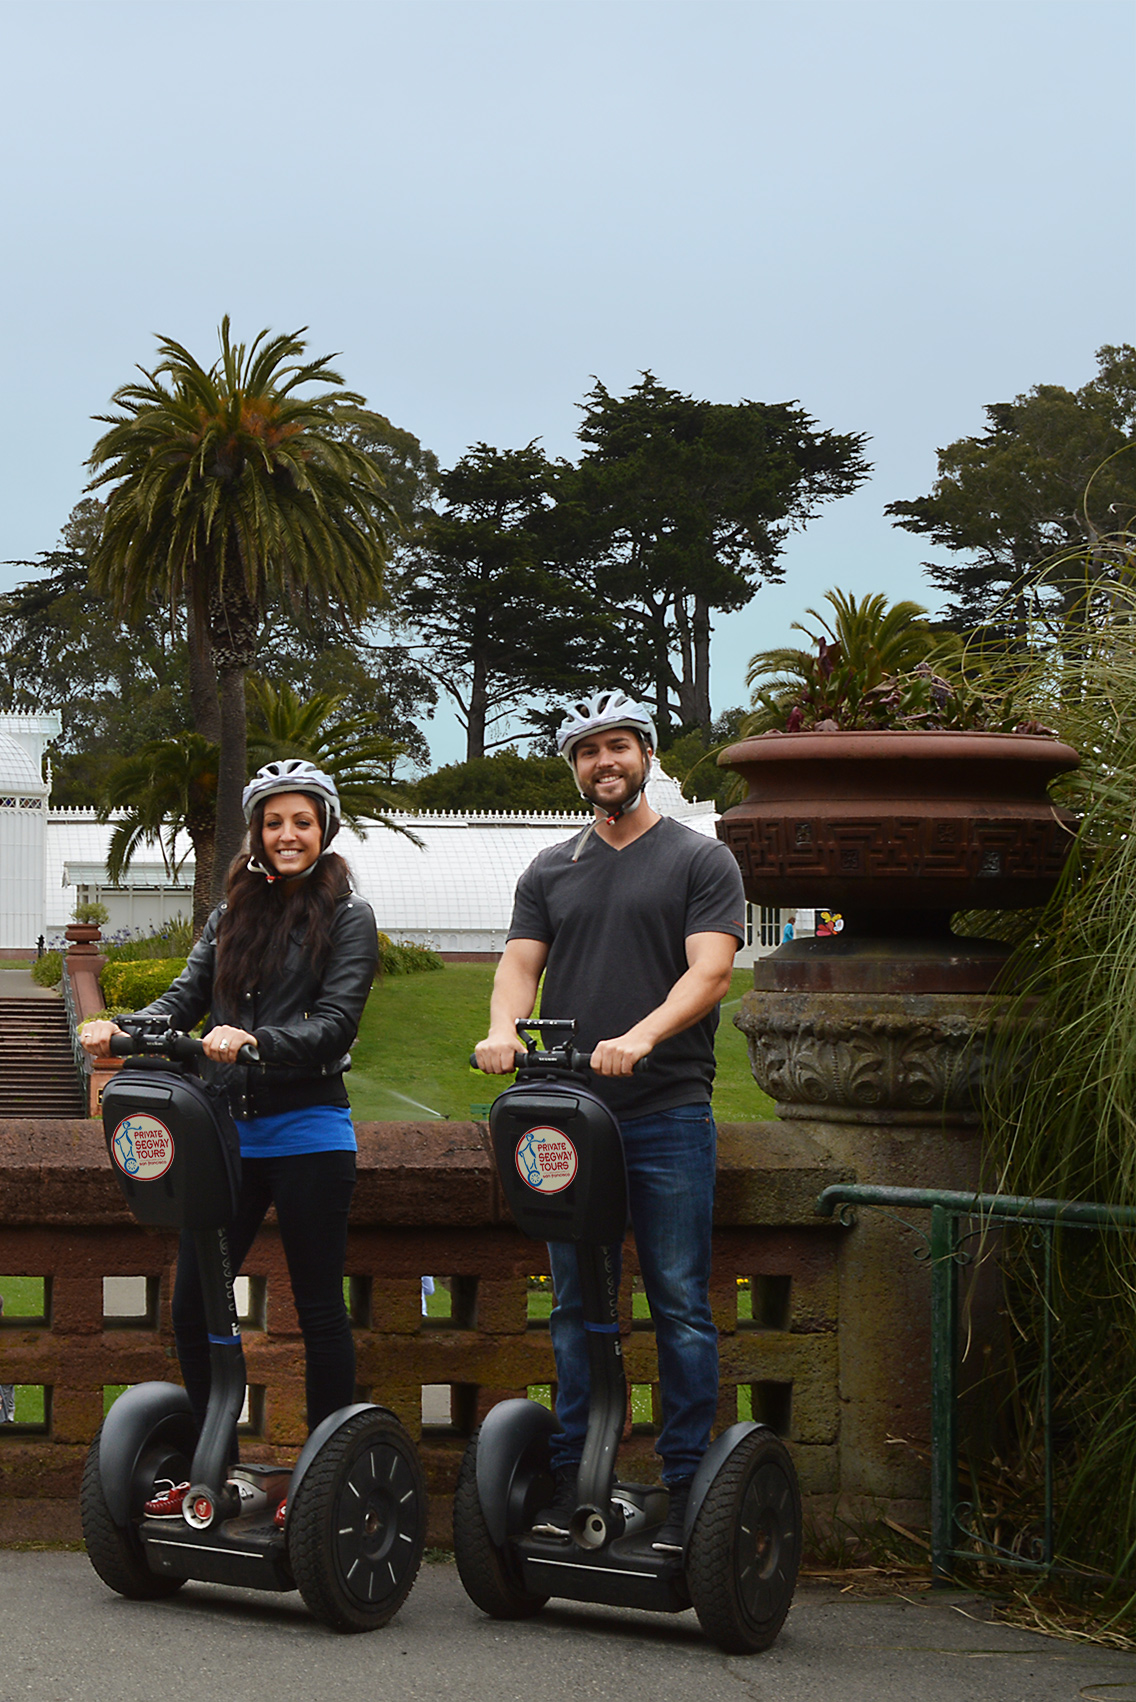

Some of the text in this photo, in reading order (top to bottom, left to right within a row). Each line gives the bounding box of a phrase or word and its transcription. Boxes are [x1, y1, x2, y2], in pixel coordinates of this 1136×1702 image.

[134, 1130, 163, 1139] PRIVATE
[135, 1139, 169, 1150] SEGWAY
[538, 1142, 566, 1152] PRIVATE
[136, 1149, 165, 1159] TOURS
[539, 1151, 572, 1162] SEGWAY
[540, 1161, 569, 1171] TOURS
